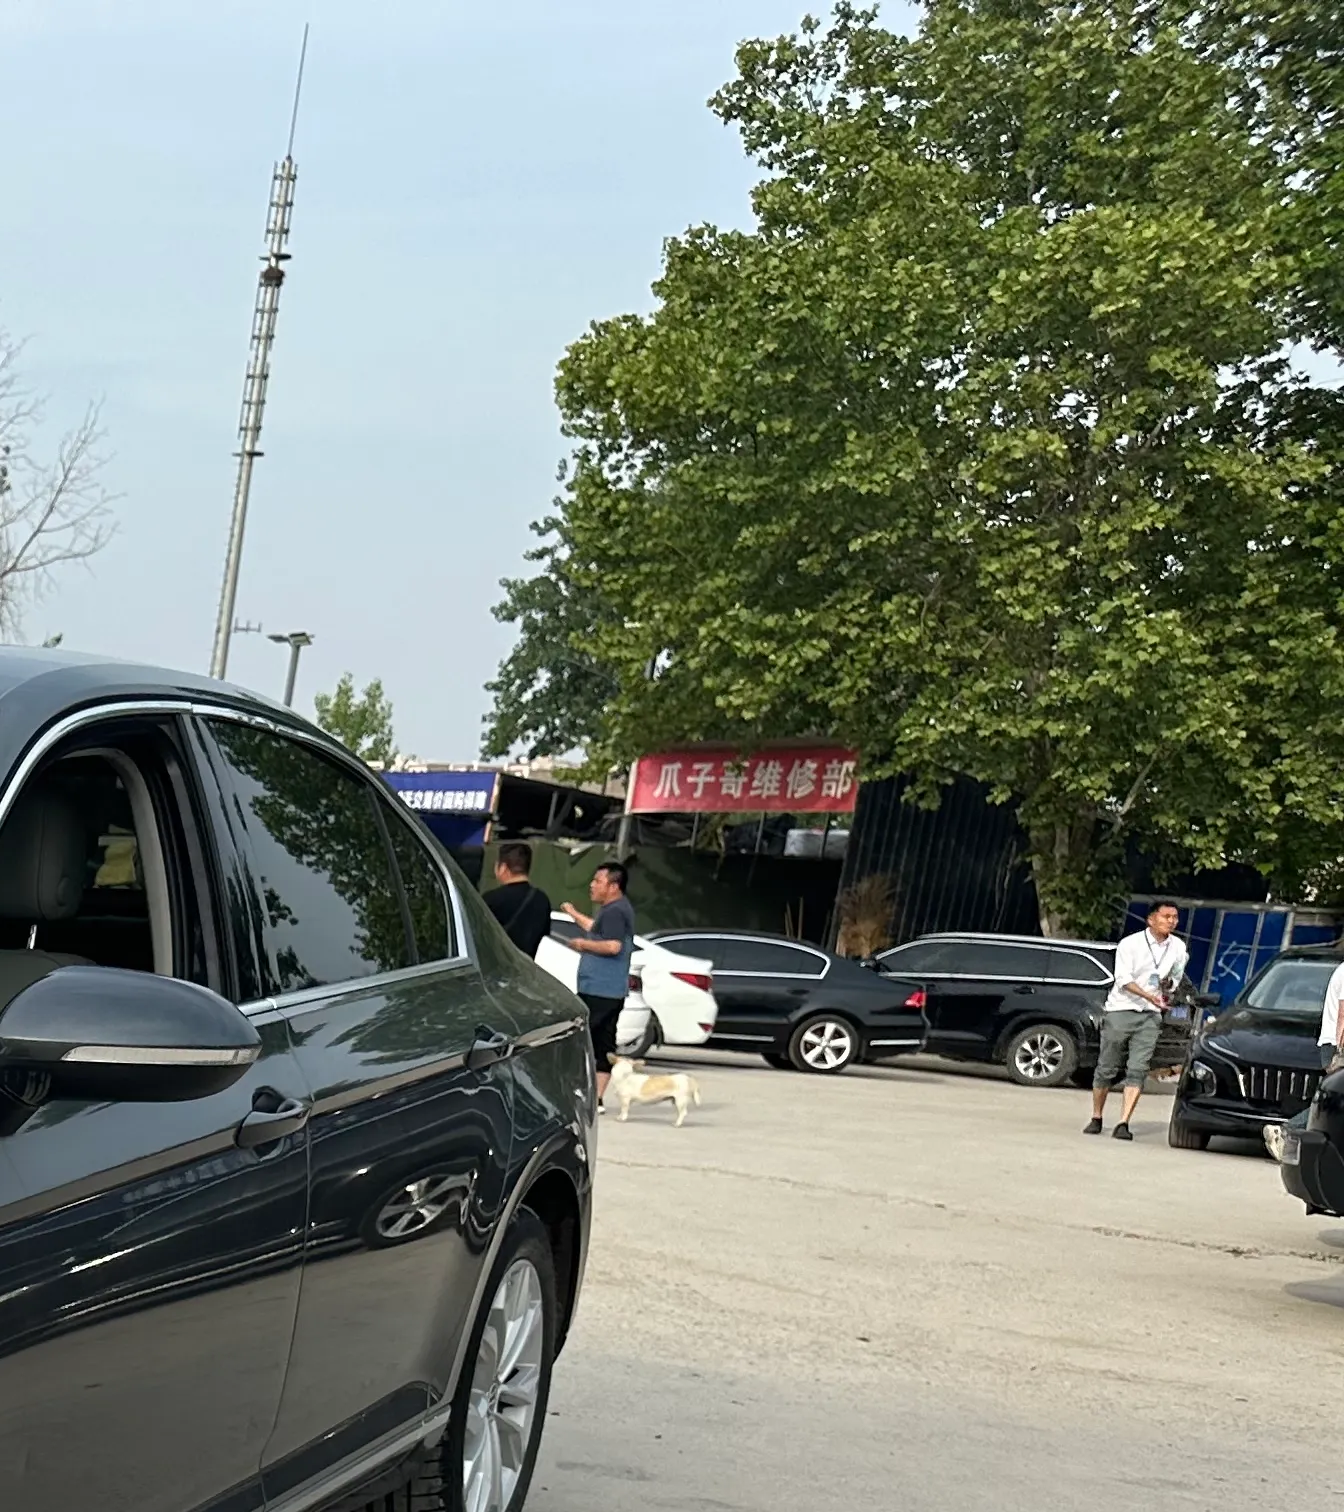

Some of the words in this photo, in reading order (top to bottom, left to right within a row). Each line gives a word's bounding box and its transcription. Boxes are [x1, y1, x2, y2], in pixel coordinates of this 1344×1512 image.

[653, 758, 857, 800] 爪子哥维修部
